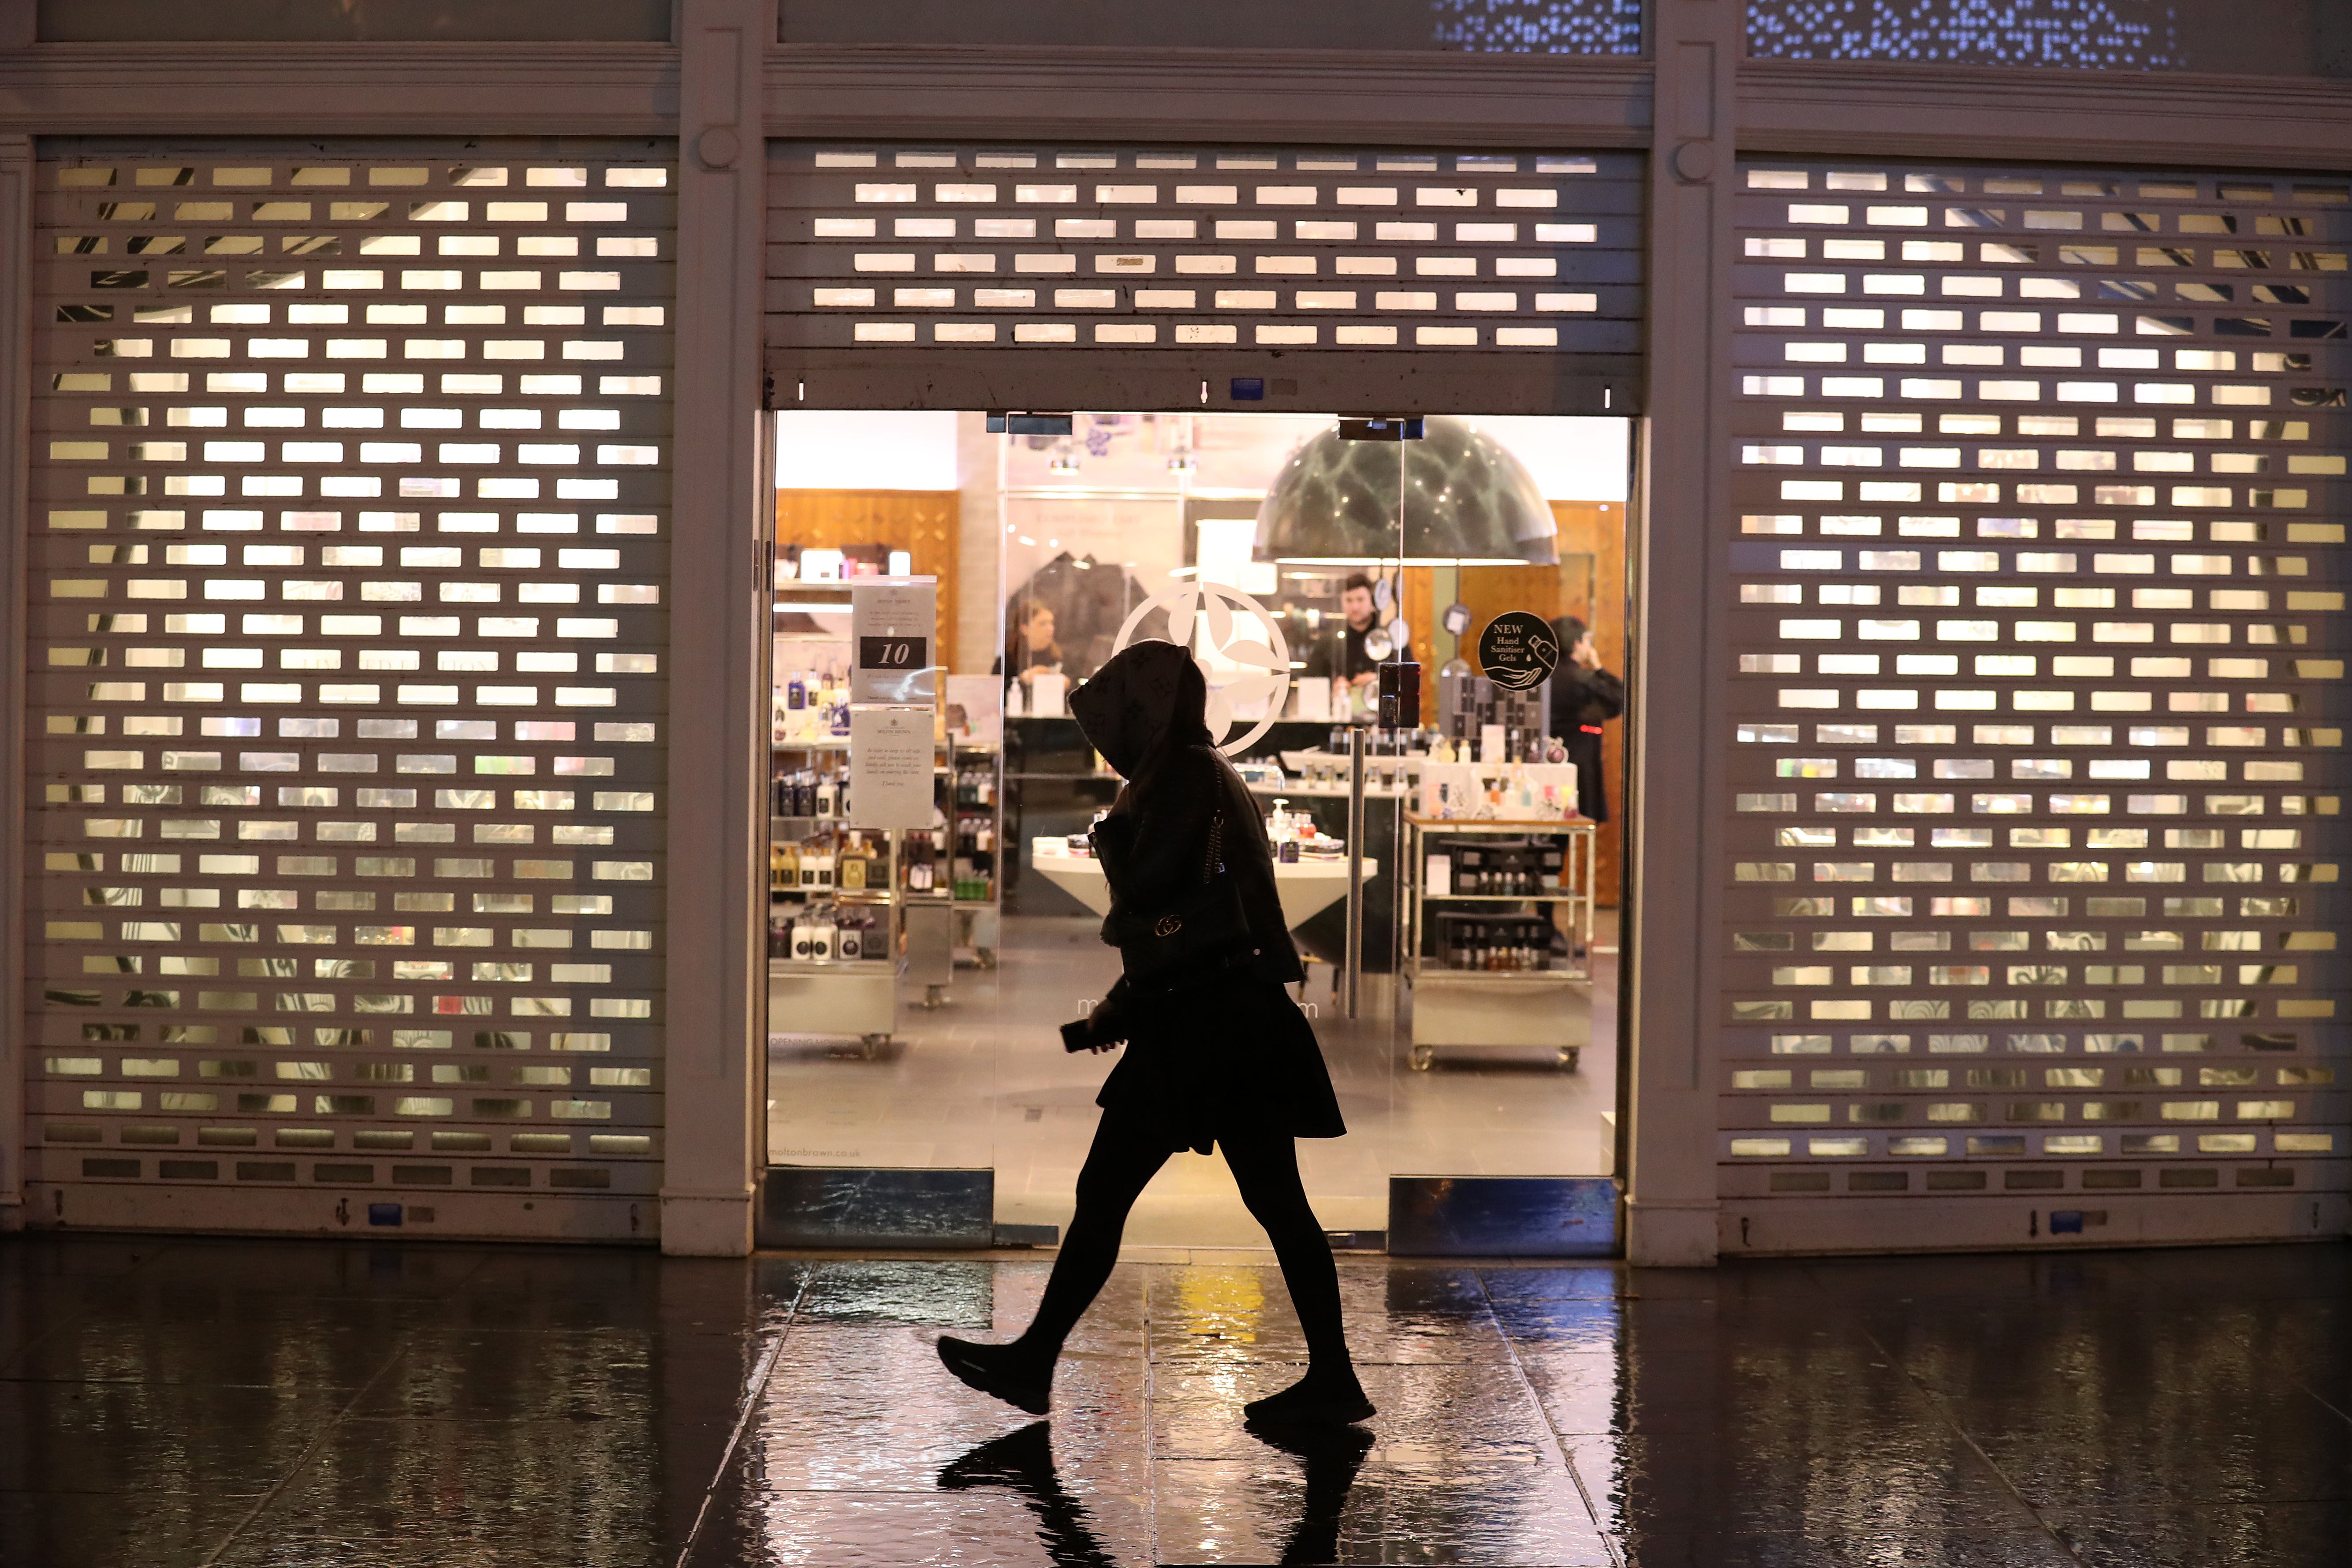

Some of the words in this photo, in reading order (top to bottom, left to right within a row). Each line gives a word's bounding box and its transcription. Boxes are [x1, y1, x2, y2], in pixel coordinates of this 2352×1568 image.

[1493, 624, 1524, 634] NEW
[1497, 637, 1519, 645] Hand
[878, 643, 909, 664] 10
[1498, 654, 1517, 662] Gels
